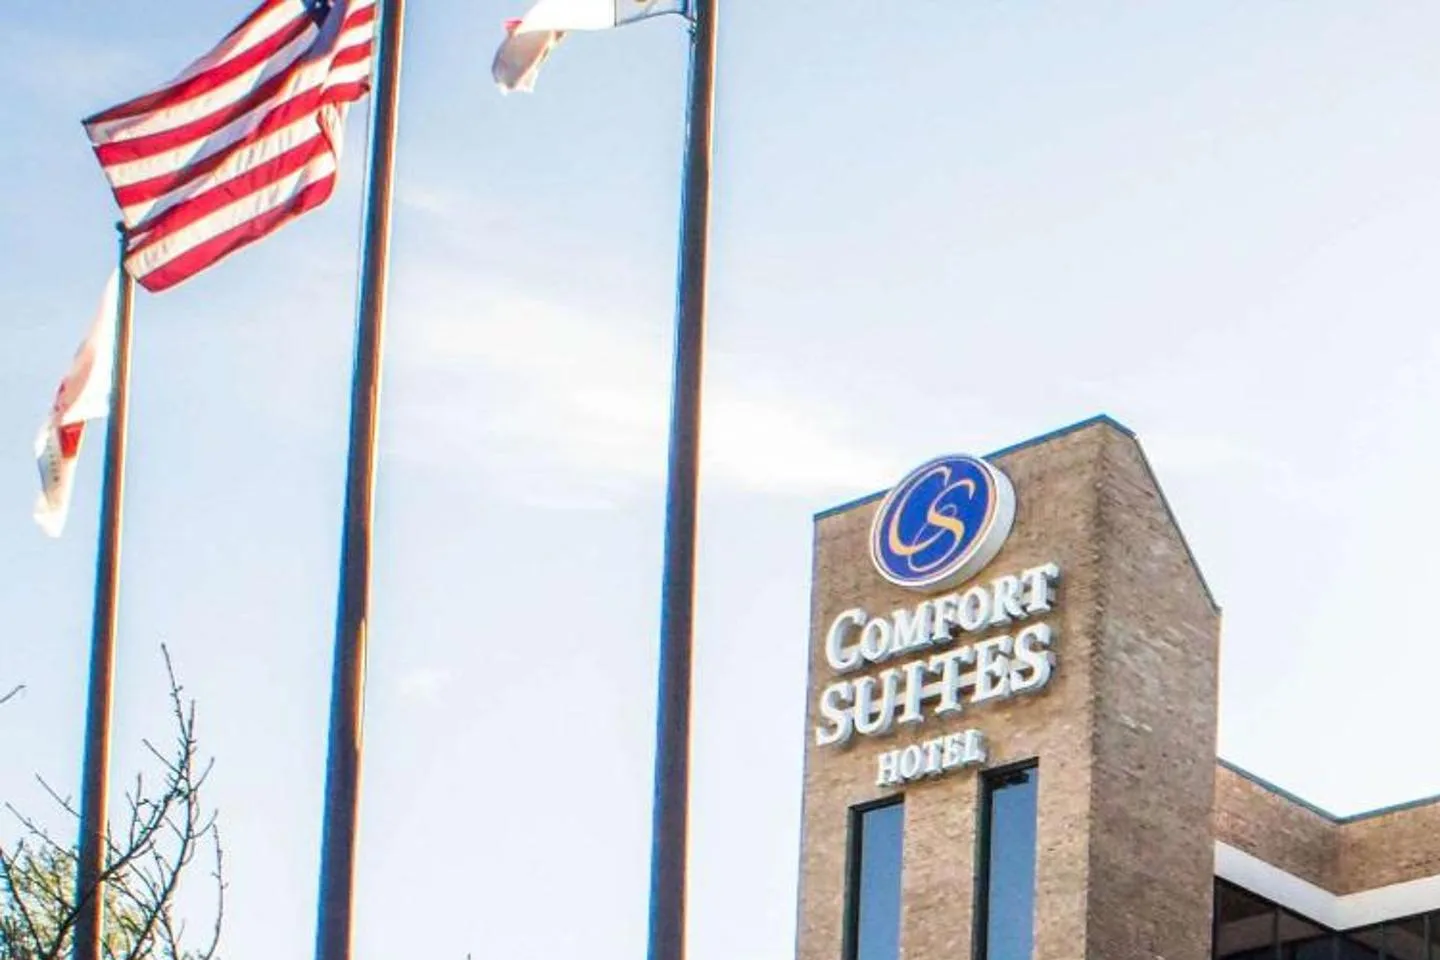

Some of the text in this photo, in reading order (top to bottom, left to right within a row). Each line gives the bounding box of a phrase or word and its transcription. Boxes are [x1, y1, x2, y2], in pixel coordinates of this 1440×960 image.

[825, 562, 1060, 674] COMFORT
[815, 621, 1057, 746] SUITES
[875, 728, 987, 787] HOTEL
